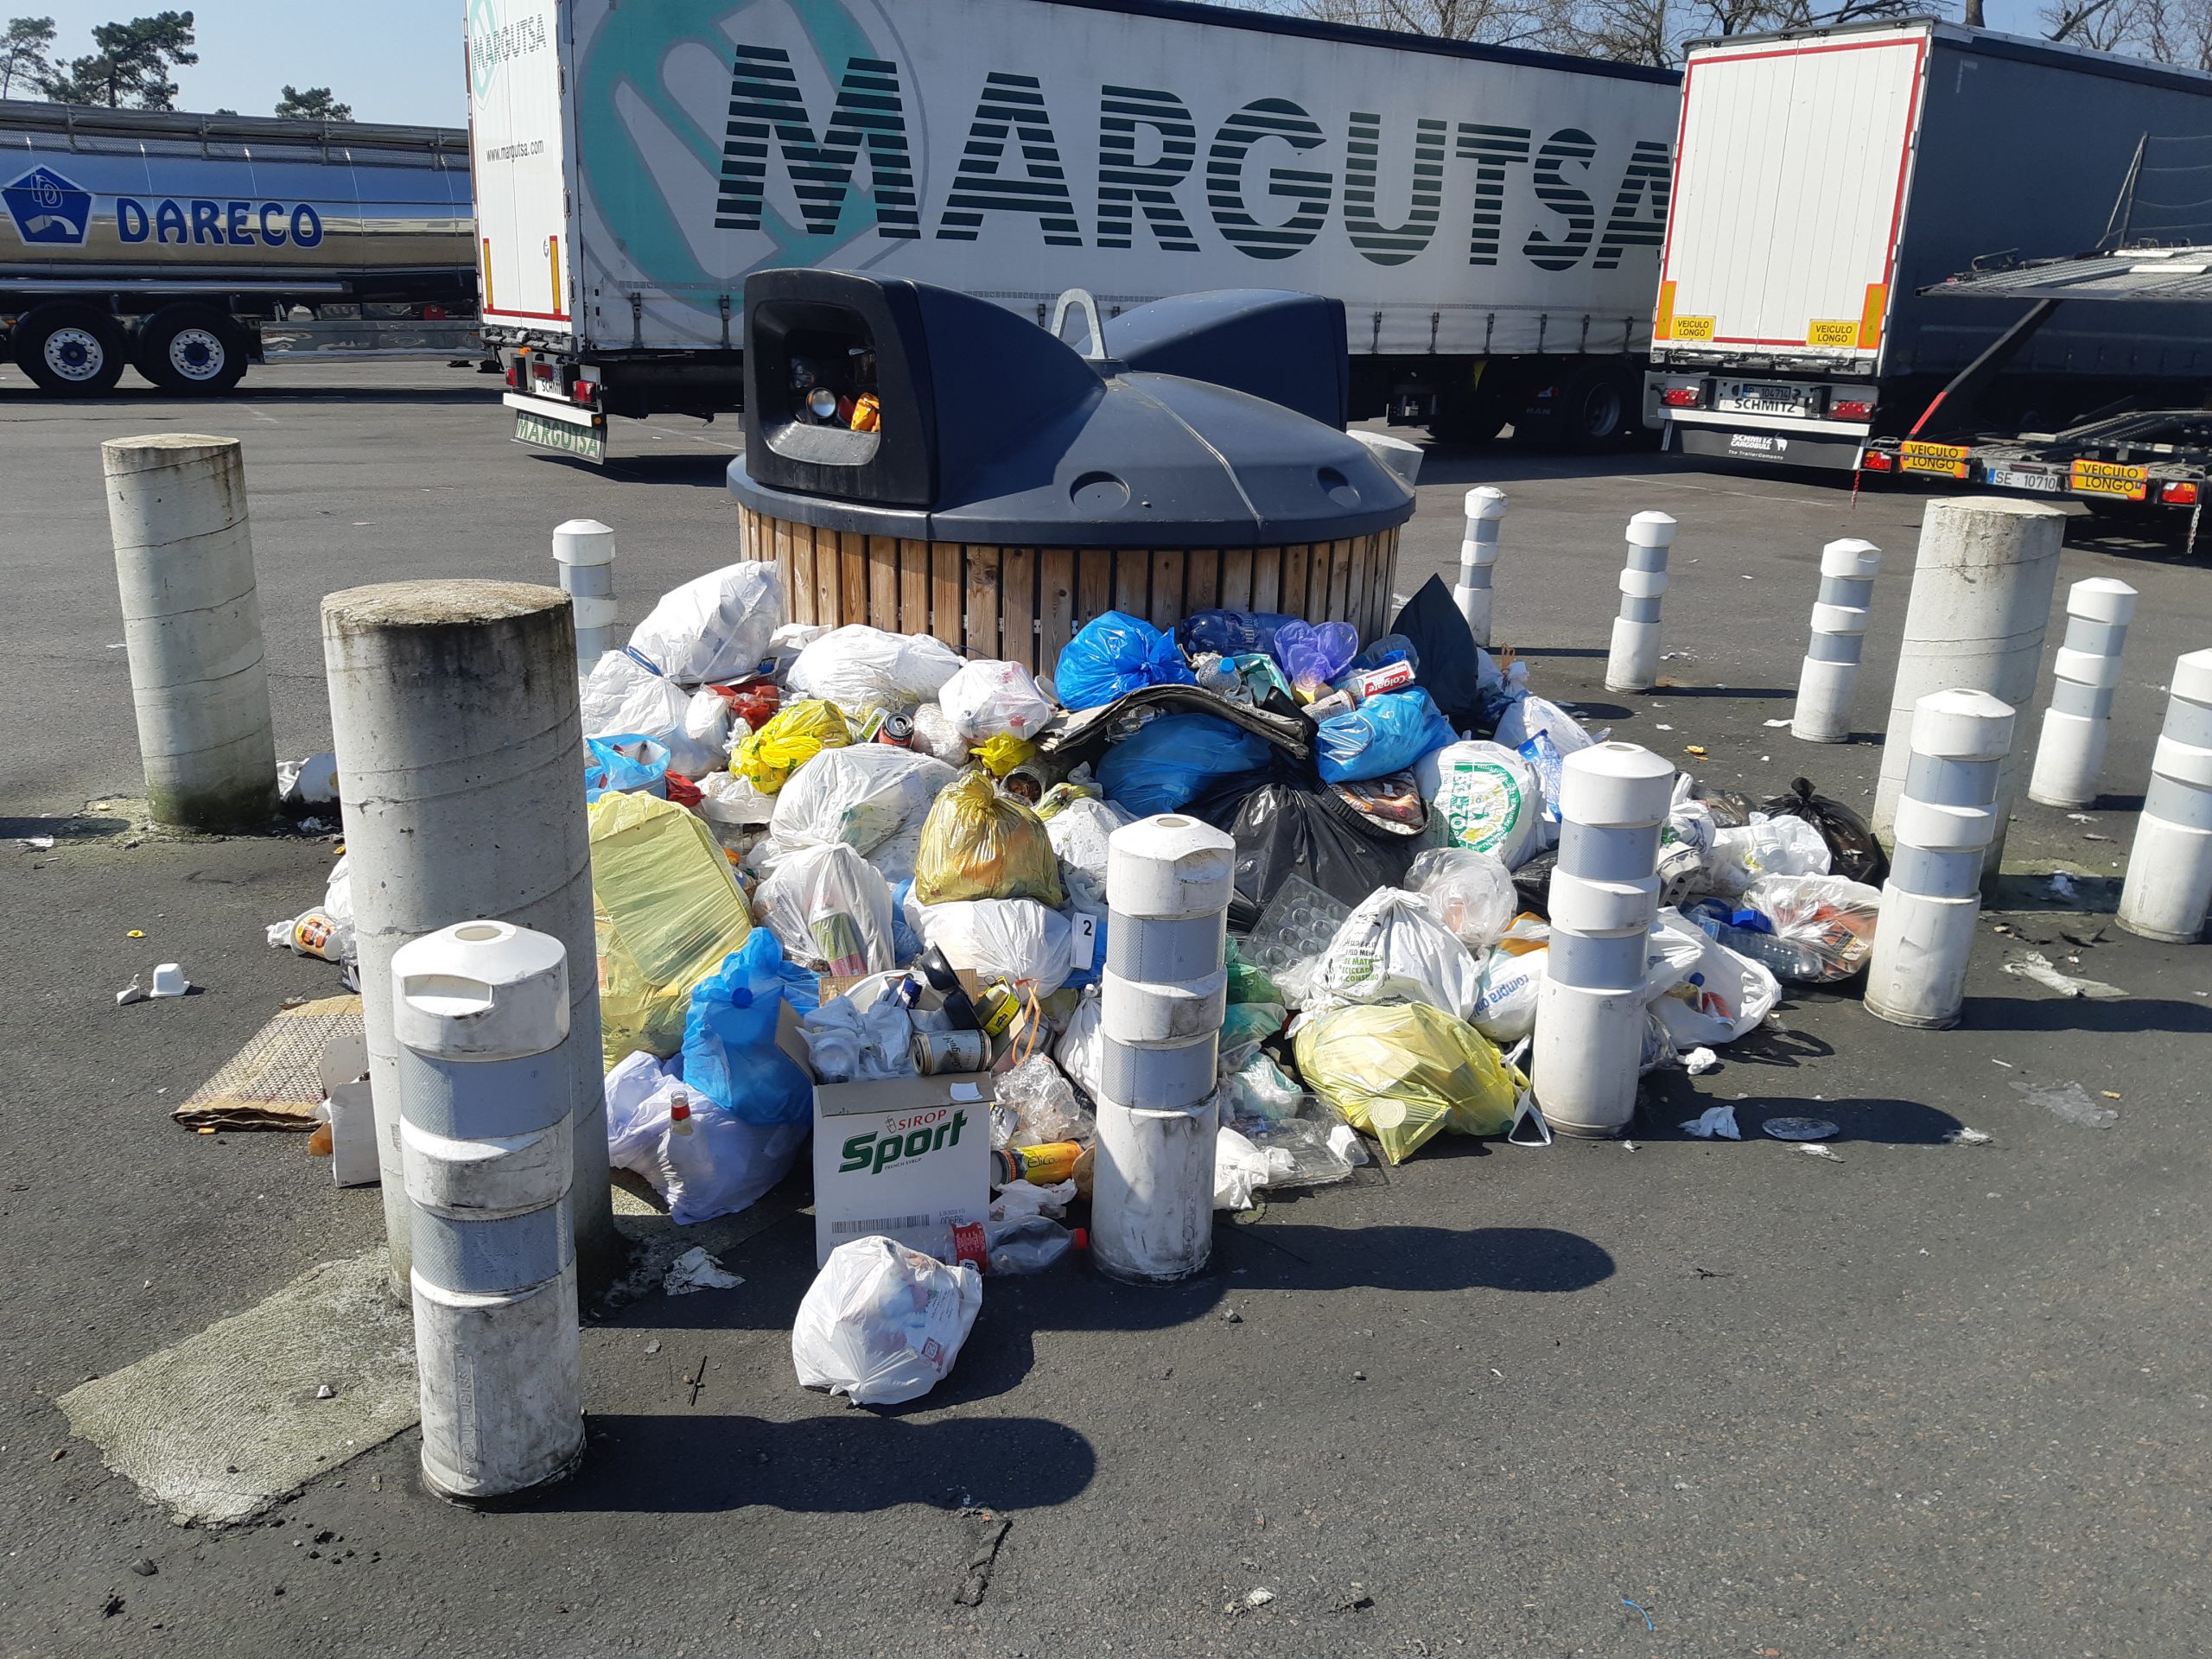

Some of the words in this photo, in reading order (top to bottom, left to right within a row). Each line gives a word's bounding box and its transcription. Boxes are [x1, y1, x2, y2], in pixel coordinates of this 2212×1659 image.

[474, 13, 547, 71] MARGUTSA
[714, 44, 1672, 271] MARGUTSA
[116, 196, 324, 248] DARECO
[1677, 320, 1709, 329] VEICULO
[1679, 328, 1706, 337] LONGO
[1815, 325, 1853, 334] VEICULO
[1817, 334, 1848, 343] LONGO
[1734, 397, 1796, 413] SCHMITZ
[1731, 441, 1770, 450] CARGOBULL
[1910, 443, 1959, 459] VEICULO
[1912, 457, 1955, 471] LONGO
[2082, 463, 2139, 480] VEICULO
[2024, 474, 2056, 490] 10710
[2084, 477, 2134, 492] LONGO
[1368, 675, 1406, 692] Colgate
[1083, 919, 1092, 937] 2
[1488, 974, 1529, 1003] compra
[898, 1109, 947, 1131] SIROP
[838, 1109, 969, 1175] Sport
[885, 1161, 905, 1171] FRENCH
[905, 1157, 922, 1166] SYRUP
